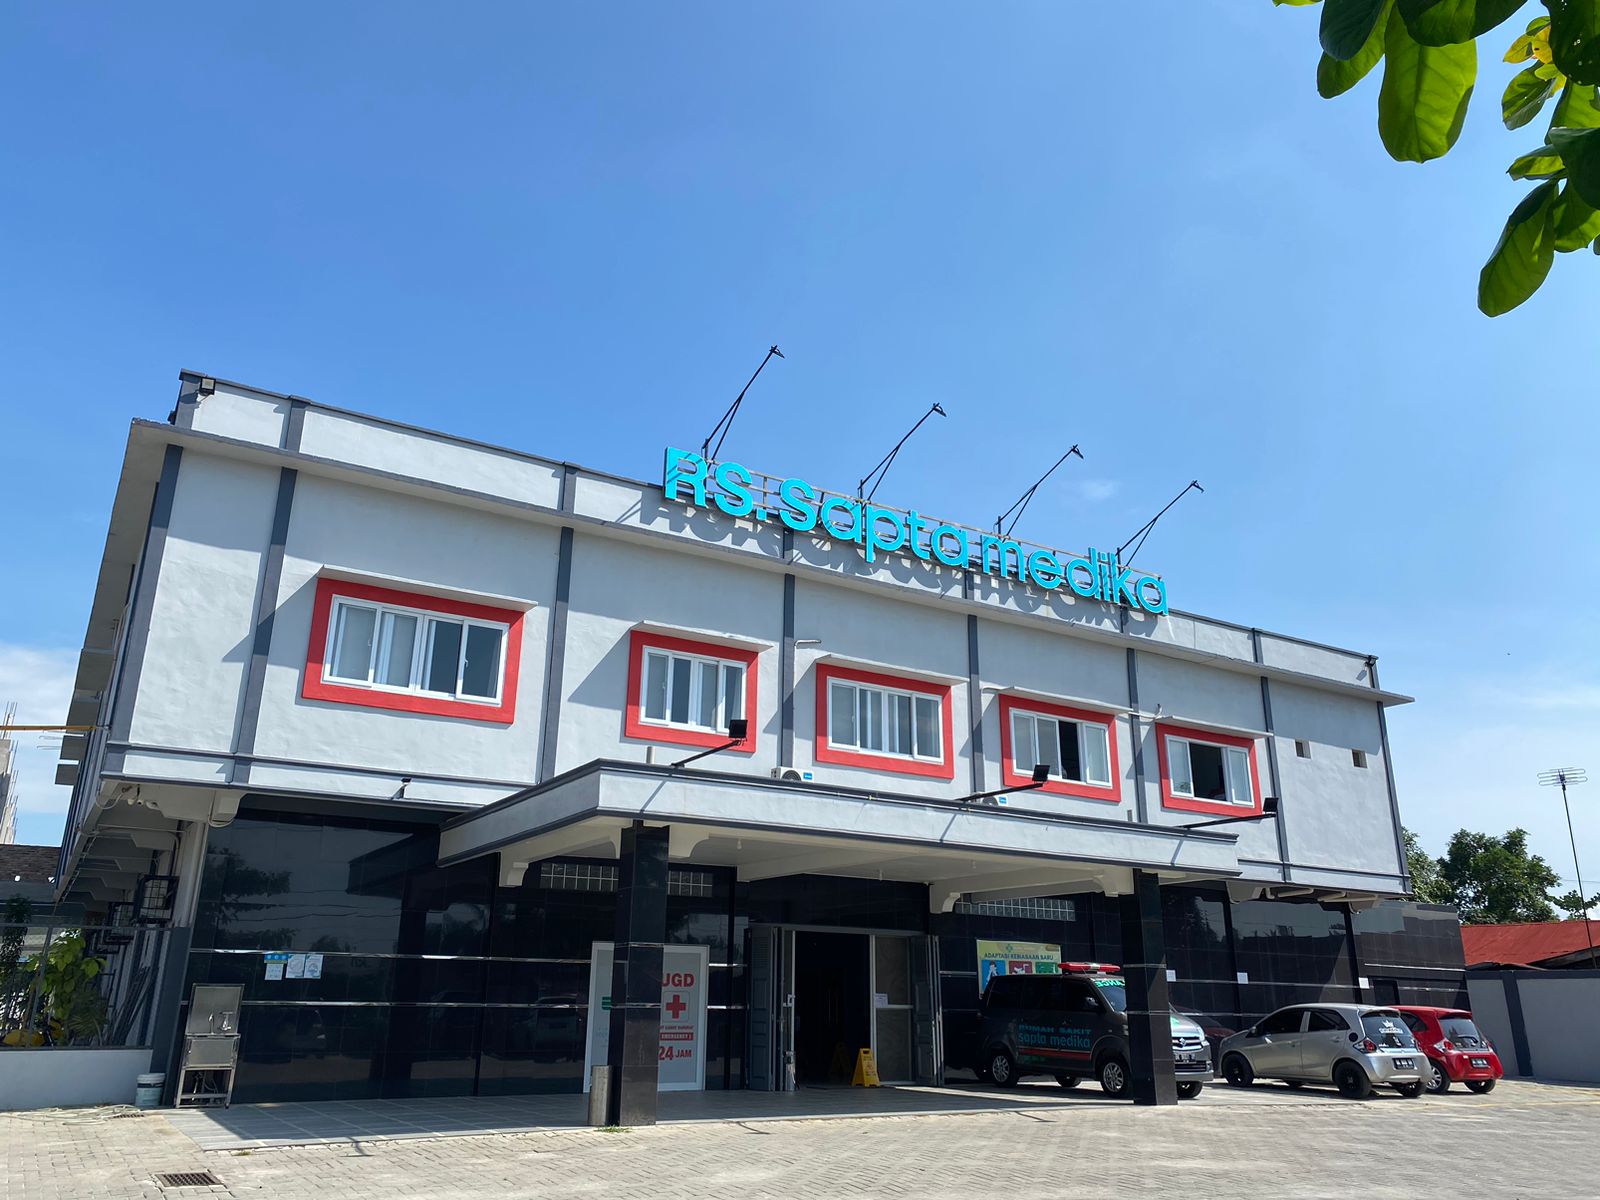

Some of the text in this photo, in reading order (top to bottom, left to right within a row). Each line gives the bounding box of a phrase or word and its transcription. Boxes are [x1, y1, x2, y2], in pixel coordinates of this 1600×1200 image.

[982, 535, 1170, 616] medika
[1059, 1027, 1092, 1035] SAKIT
[1018, 1032, 1090, 1048] sapta medika
[658, 1046, 692, 1060] 24 JAM
